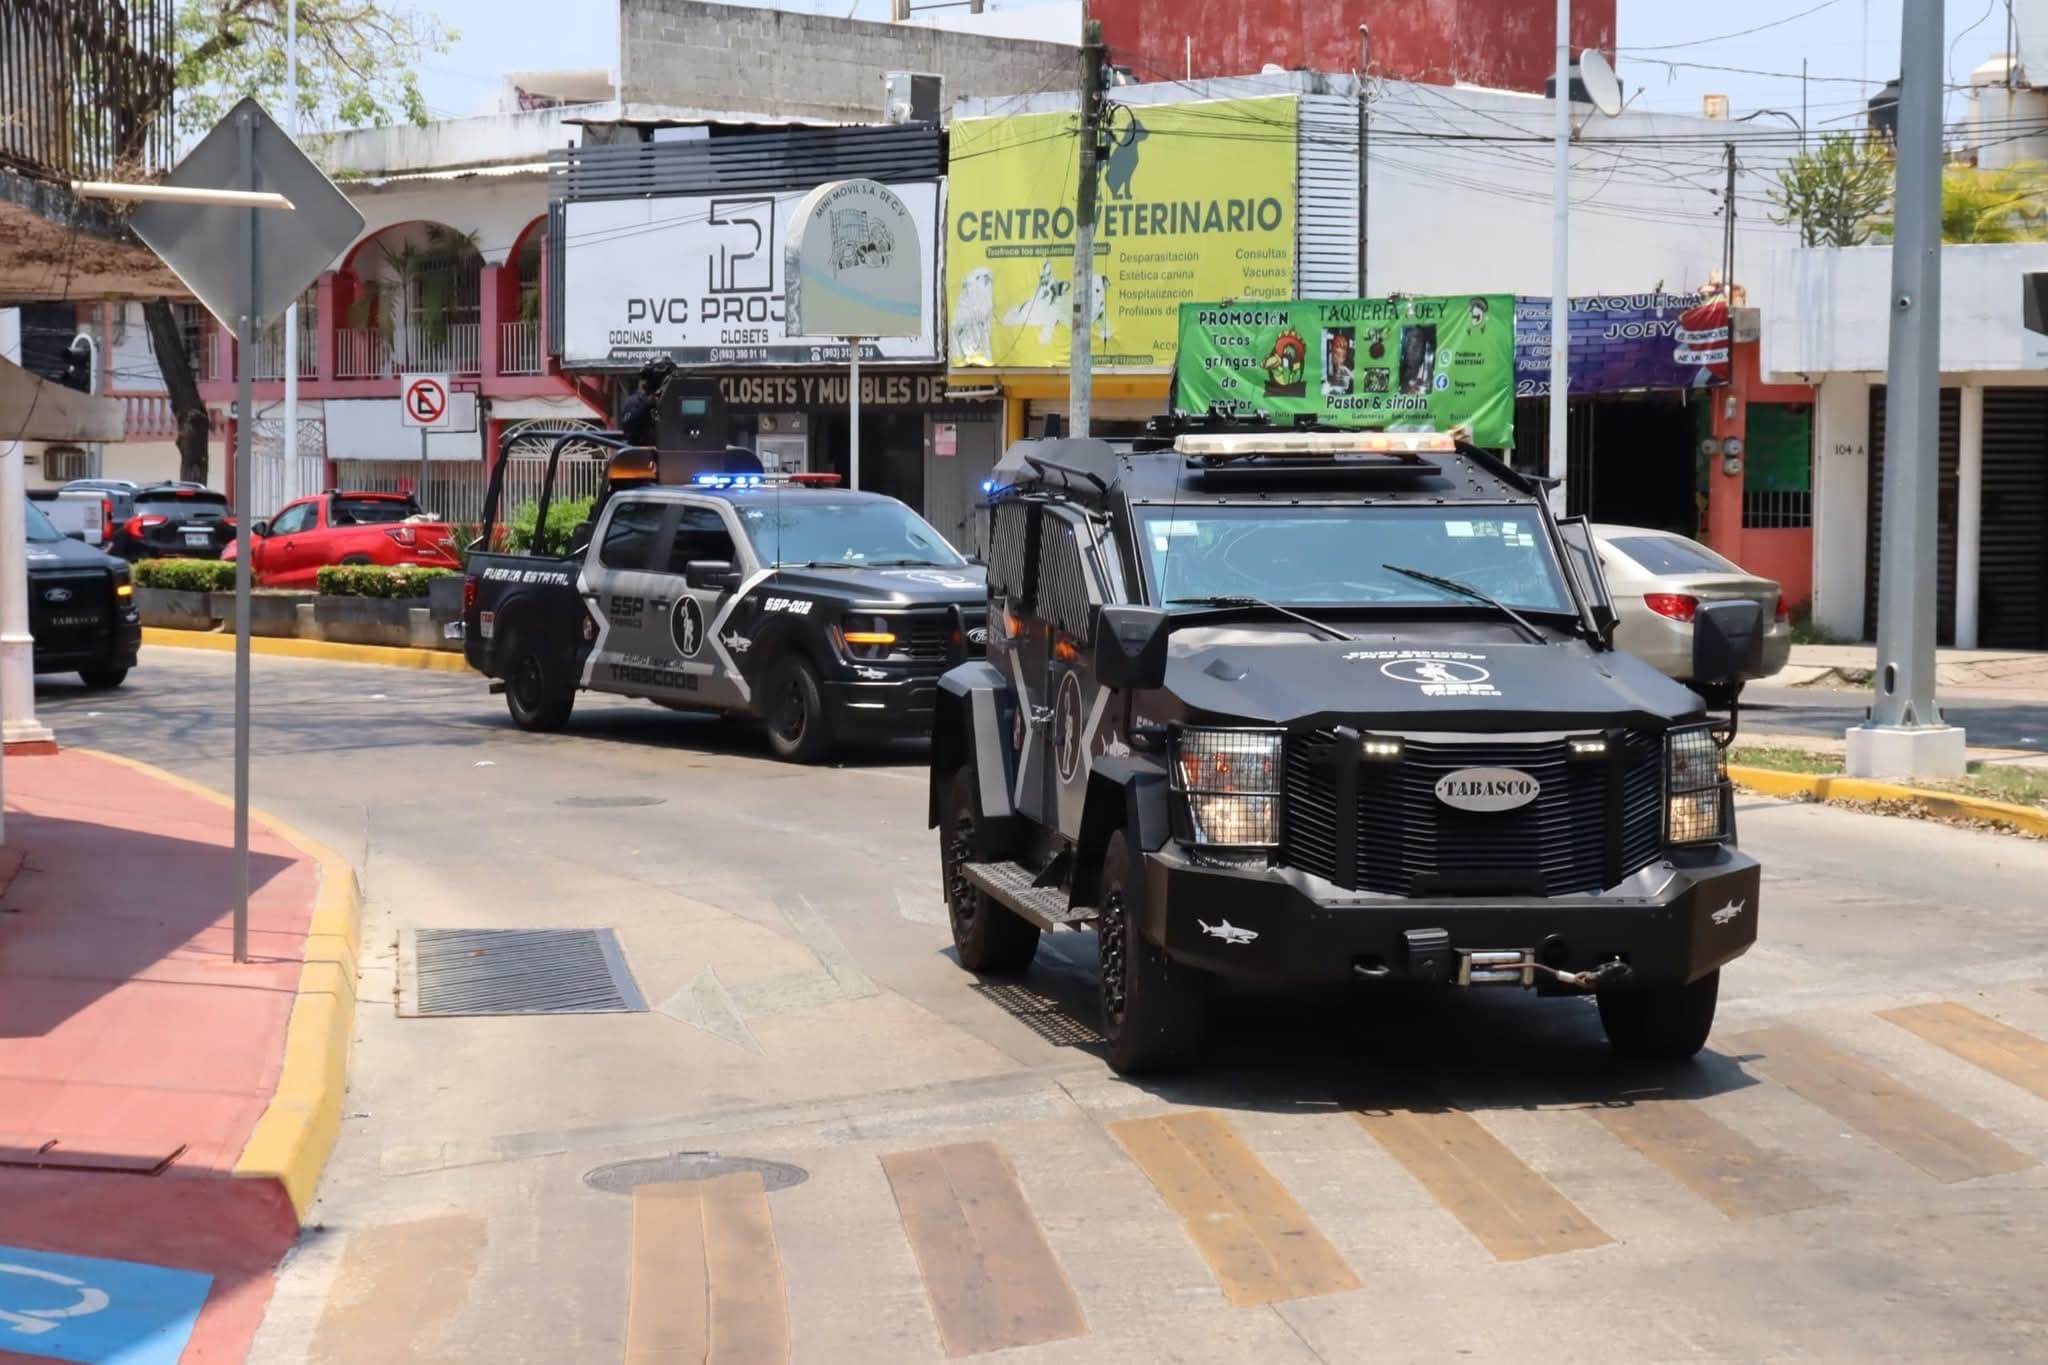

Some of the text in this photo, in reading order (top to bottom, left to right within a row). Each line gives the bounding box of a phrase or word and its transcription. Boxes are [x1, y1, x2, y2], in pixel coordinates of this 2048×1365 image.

[833, 184, 860, 201] MOVIL
[957, 206, 1074, 242] CENTRO
[1235, 248, 1287, 260] Consultas
[1119, 267, 1287, 281] Estética canina Vacunas
[627, 296, 786, 324] PVC PROJ
[1119, 305, 1163, 317] Profilaxis
[608, 329, 769, 345] COCINAS CLOSETS
[1602, 320, 1678, 340] JOEY
[1152, 340, 1178, 351] Acce
[1211, 333, 1251, 346] Tacos
[1205, 357, 1257, 371] gringas
[720, 377, 797, 403] CLOSETS
[801, 378, 814, 403] Y
[818, 375, 912, 404] MUBLES
[916, 376, 943, 404] DE
[1221, 376, 1238, 388] de
[1326, 395, 1371, 410] Pastor
[1372, 396, 1382, 410] &
[1835, 443, 1865, 456] 104 A
[482, 567, 569, 586] FUERZA ESTATAL
[610, 596, 644, 617] SSP
[1443, 781, 1532, 796] TABASCO
